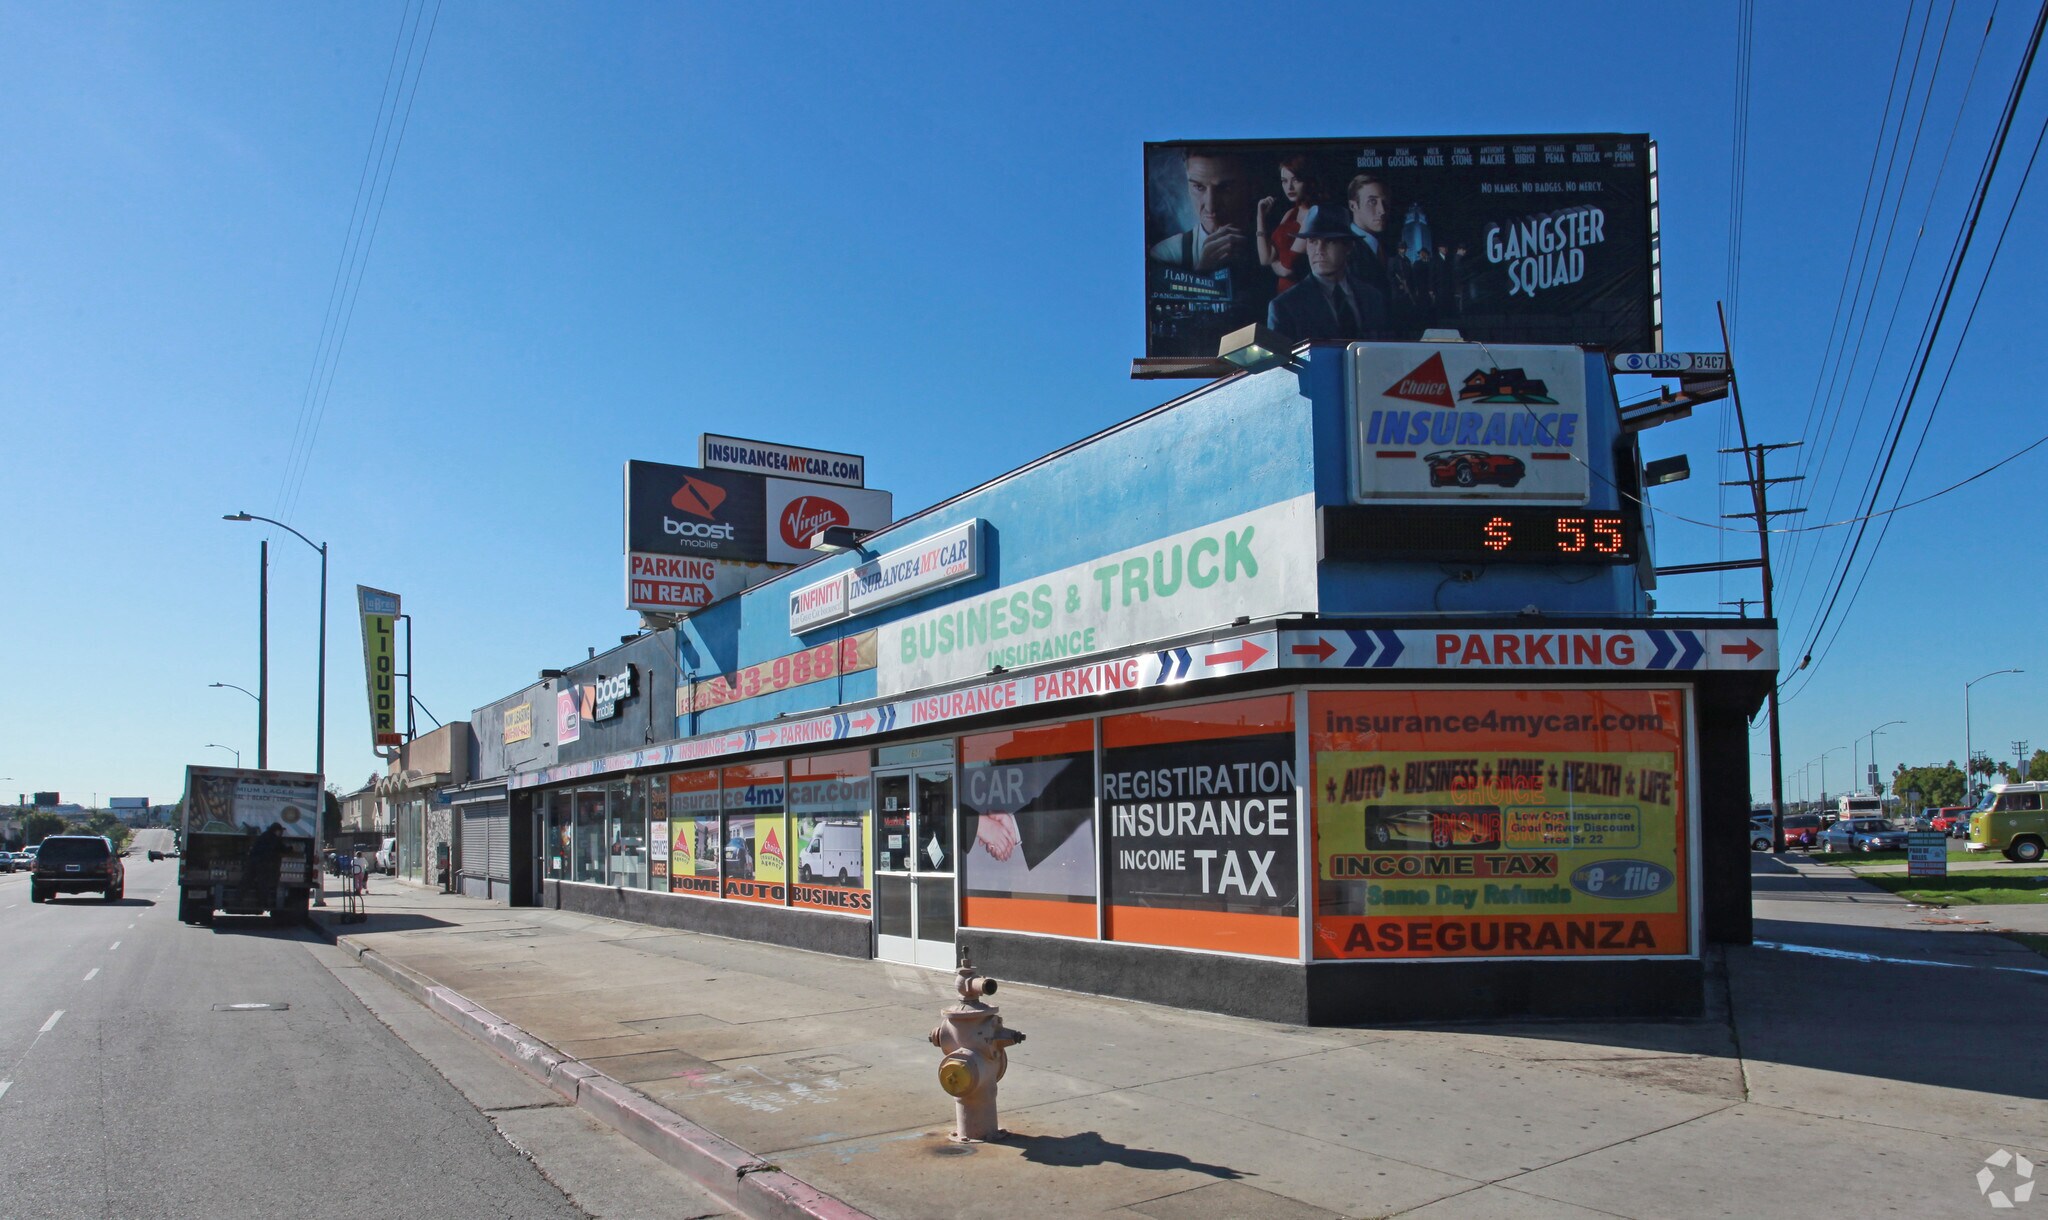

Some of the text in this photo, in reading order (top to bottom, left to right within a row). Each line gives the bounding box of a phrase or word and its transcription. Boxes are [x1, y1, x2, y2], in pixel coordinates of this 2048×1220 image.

[1357, 157, 1382, 168] BROLIN
[1388, 156, 1418, 167] GOSLING
[1423, 155, 1444, 166] NOLTE
[1451, 154, 1473, 166] STONE
[1480, 153, 1506, 165] MACKIE
[1514, 153, 1535, 164] RIBISI
[1572, 152, 1600, 163] PATRICK
[1615, 151, 1634, 162] PENN
[1486, 207, 1605, 263] GANGSTER
[1508, 248, 1584, 298] SQUAD
[1645, 353, 1681, 370] CBS
[1399, 379, 1446, 396] Choice
[1366, 410, 1579, 448] INSURANCE
[707, 442, 860, 481] INSURANCE4MYCAR.COM
[663, 515, 735, 541] boost
[787, 497, 837, 542] Virgin
[680, 538, 719, 549] mobile
[1484, 517, 1512, 551] $
[631, 555, 715, 581] PARKING
[849, 538, 968, 601] INSURANCE4MYCAR
[634, 583, 706, 604] IN REAR
[800, 580, 842, 613] INFINITY
[901, 525, 1259, 665] BUSINESS & TRUCK
[987, 627, 1096, 669] INSURANCE
[1435, 634, 1636, 666] PARKING
[376, 617, 390, 729] LIQUOR
[596, 665, 631, 705] boost
[911, 658, 1139, 724] INSURANCE PARKING
[596, 702, 615, 719] mobile
[1326, 709, 1665, 738] insurance4mycar.com
[780, 720, 832, 745] PARKING
[679, 737, 726, 760] INSURANCE
[970, 767, 1026, 806] CAR
[1341, 758, 1672, 807] AUTO BUSINESS HOME HEALTH LIFE
[1450, 775, 1547, 805] CHOICE
[1111, 799, 1289, 837] INSURANCE
[1432, 811, 1568, 843] INSURANCE
[1511, 823, 1636, 833] Good Driver Discount
[1515, 811, 1632, 821] Low Cost Insurance
[764, 840, 781, 854] Choice
[1543, 835, 1604, 845] Free Sr 22
[1119, 850, 1278, 898] INCOME TAX
[1334, 854, 1556, 877] INCOME TAX
[673, 876, 872, 910] HOME AUTO BUSINESS
[1366, 883, 1573, 910] Same Day Refunds
[1342, 920, 1658, 953] ASEGURANZA
